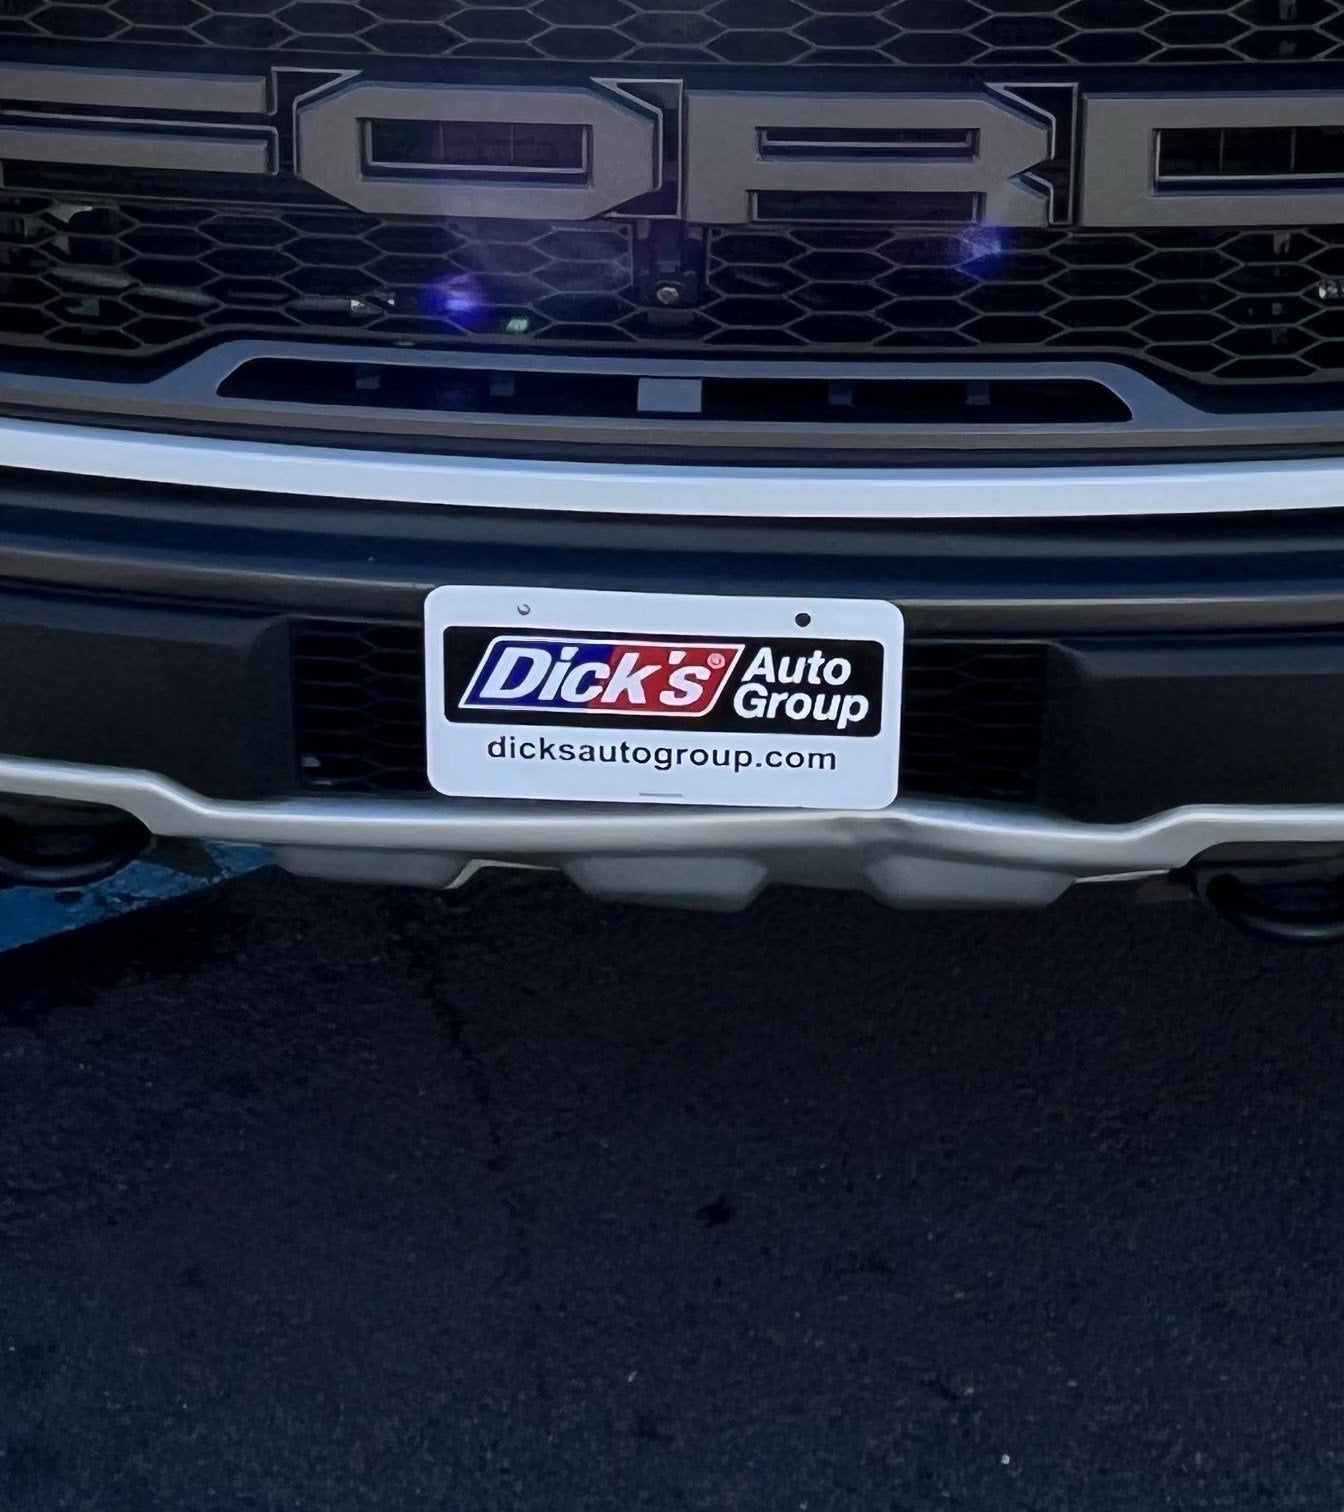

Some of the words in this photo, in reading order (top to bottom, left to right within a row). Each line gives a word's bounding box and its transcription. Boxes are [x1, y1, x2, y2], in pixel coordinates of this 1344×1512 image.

[479, 645, 712, 707] Dick's
[741, 646, 852, 687] Auto
[732, 684, 870, 730] Group
[487, 735, 838, 773] dicksautogroup.com
